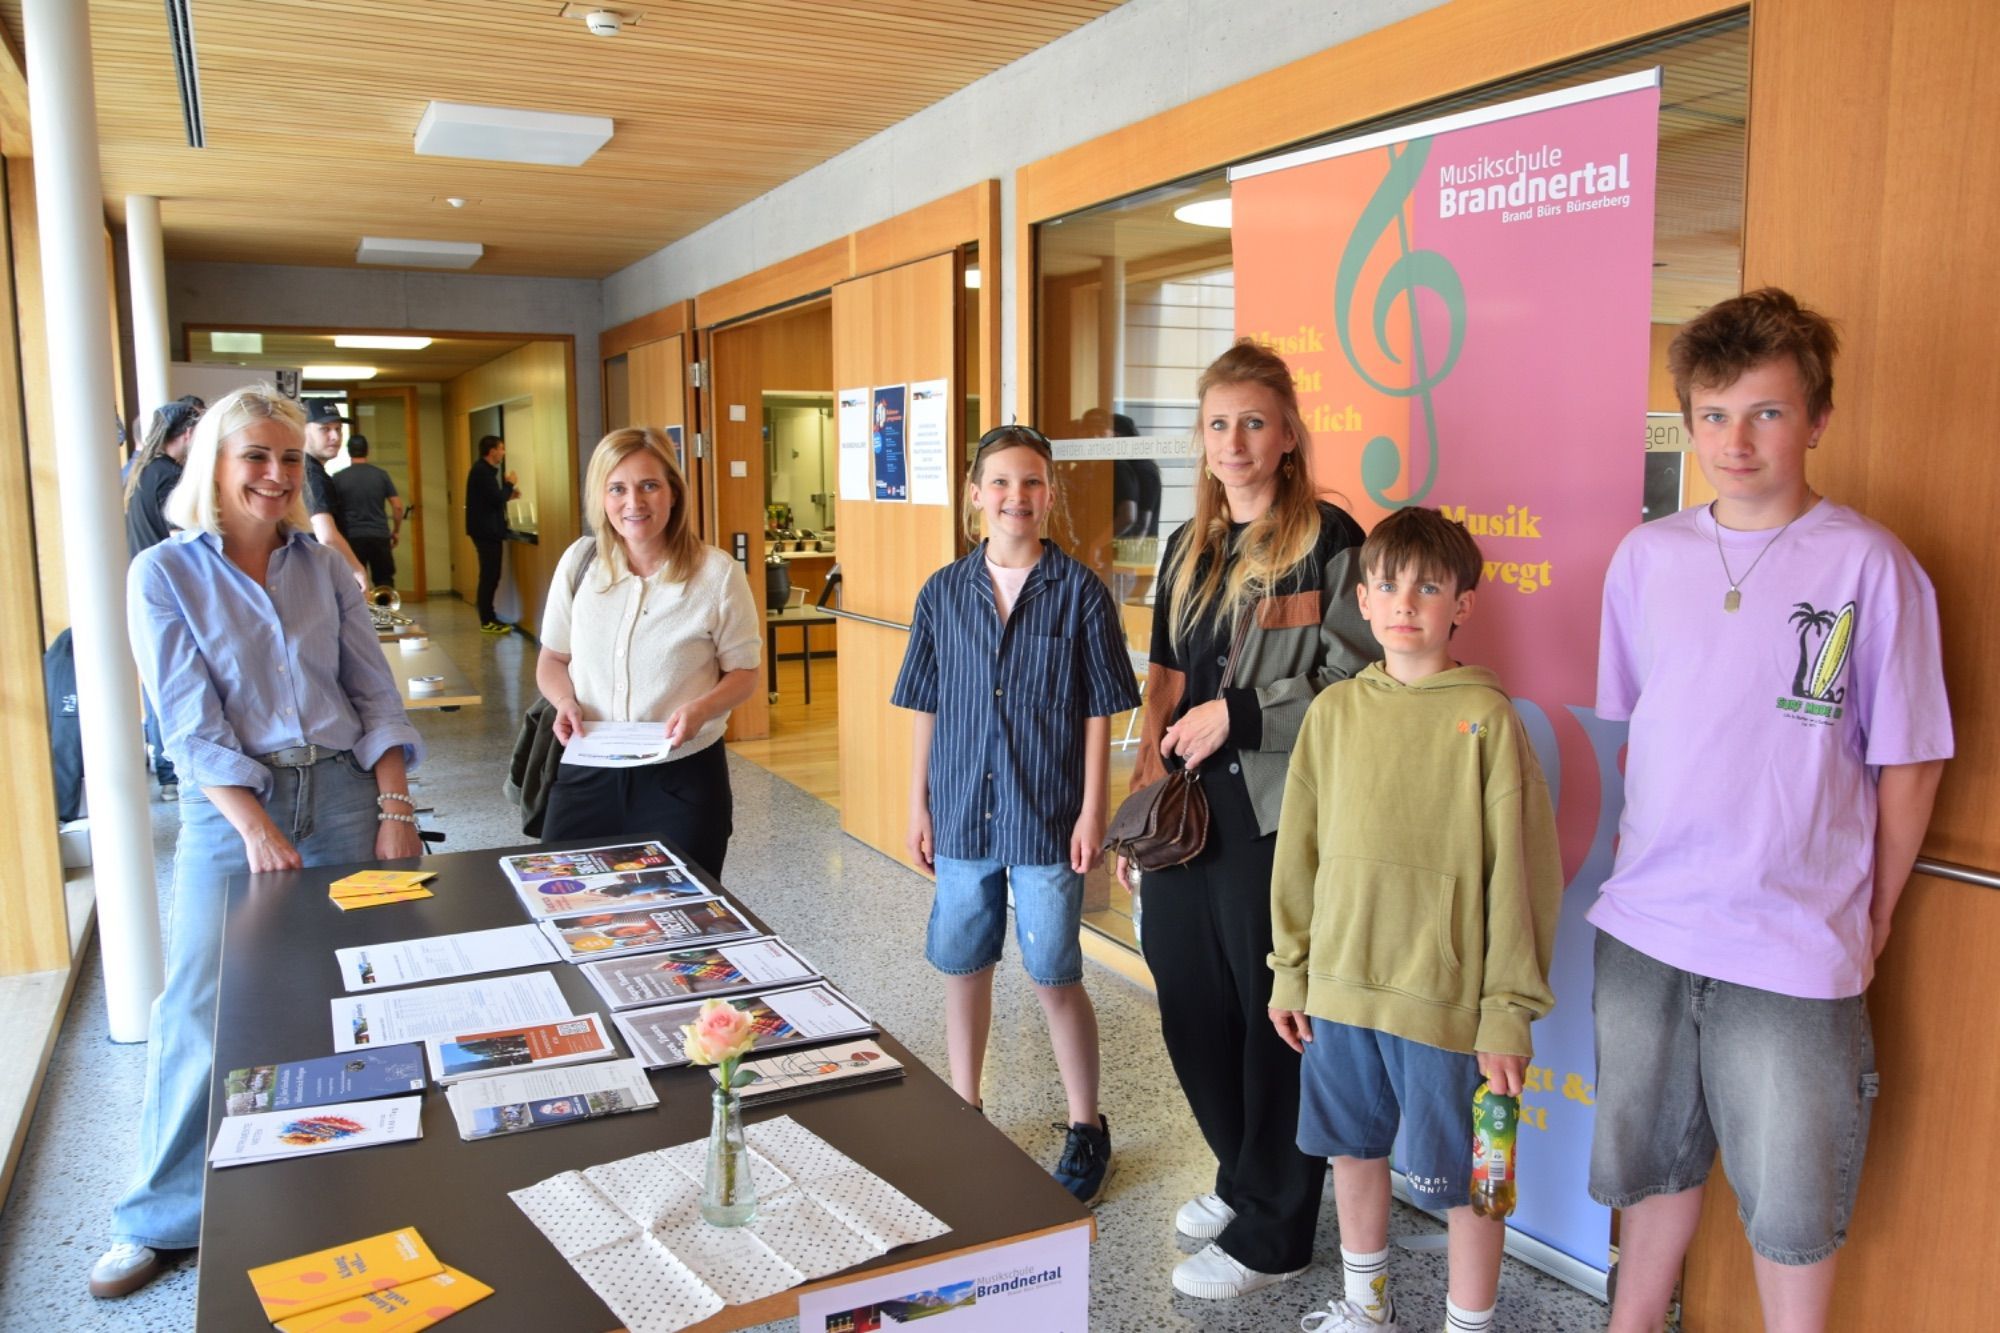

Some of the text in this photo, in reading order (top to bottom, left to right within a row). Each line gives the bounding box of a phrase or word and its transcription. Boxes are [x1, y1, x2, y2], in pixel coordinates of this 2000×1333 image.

[1440, 145, 1562, 187] Musikschule
[1439, 153, 1630, 218] Brandnertal
[1502, 195, 1630, 223] Brand Bürs Bürserberg
[977, 1265, 1034, 1286] Musikschule
[977, 1266, 1062, 1297] Brandnertal
